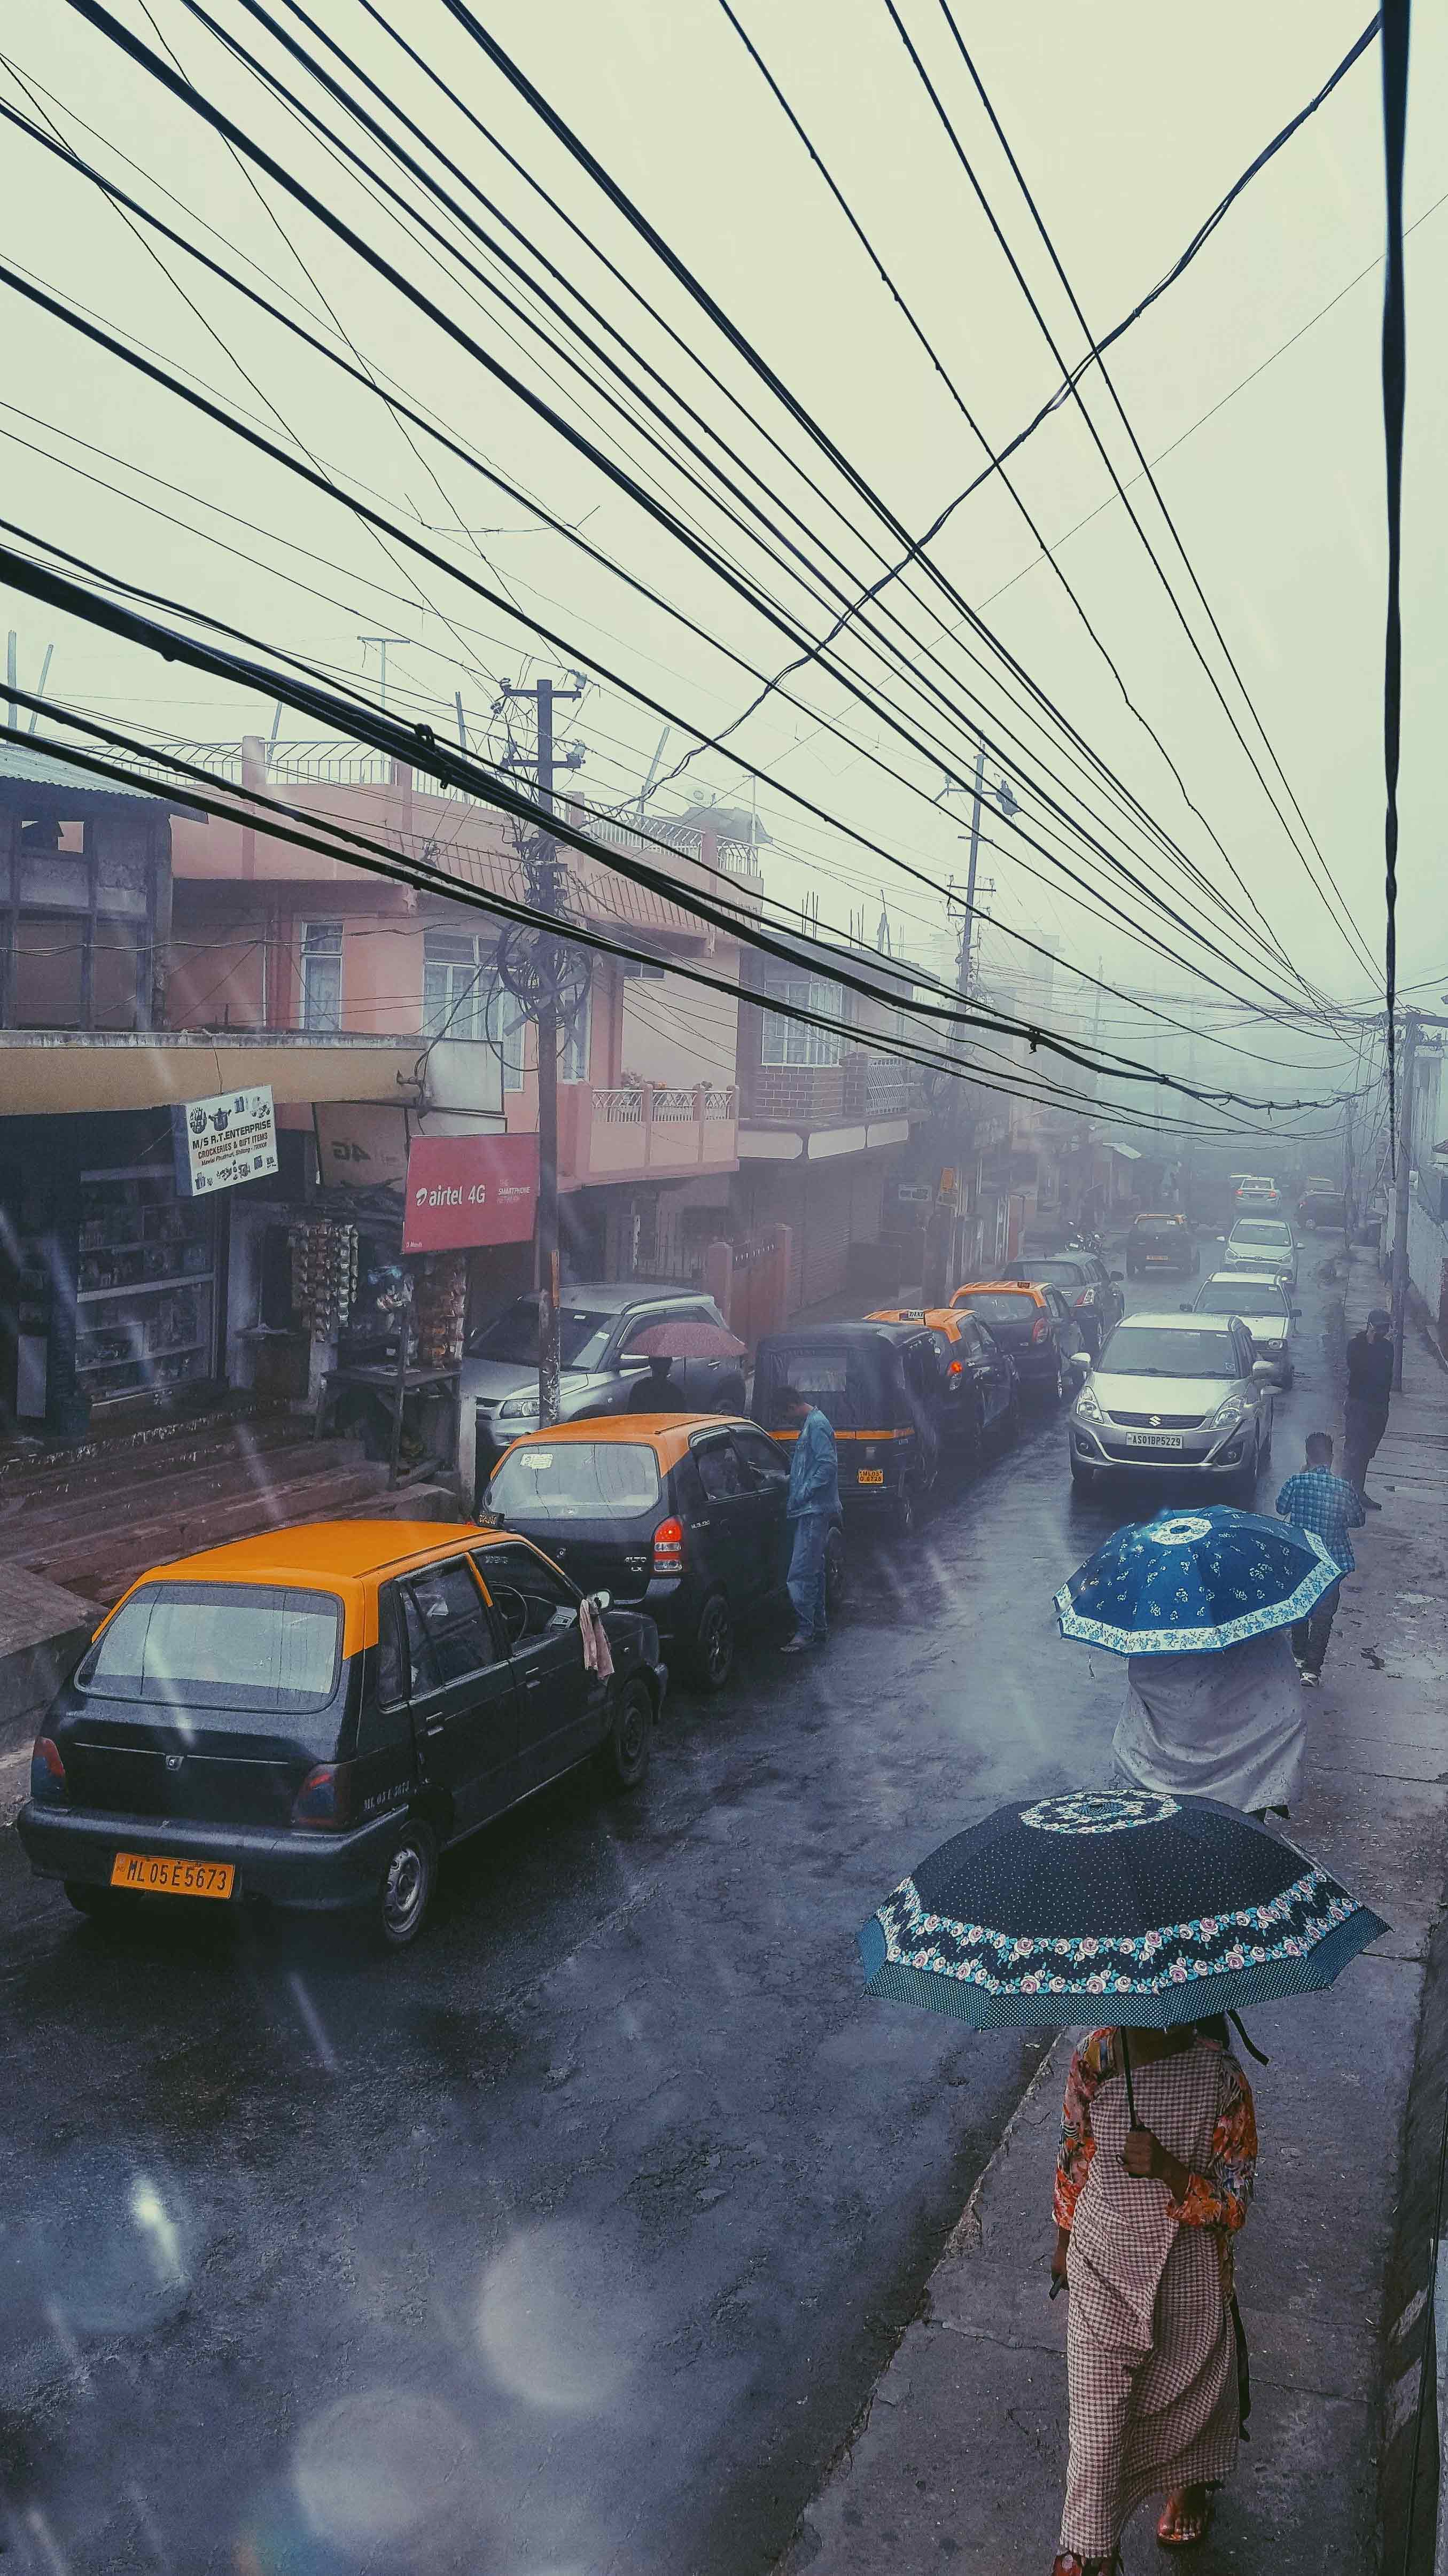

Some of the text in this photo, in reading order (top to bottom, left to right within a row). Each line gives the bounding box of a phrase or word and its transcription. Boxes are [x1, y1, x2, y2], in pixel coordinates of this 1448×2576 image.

[192, 1136, 208, 1150] M/S
[198, 1132, 268, 1159] CROCKERIES & GIFT ITEMS
[429, 1184, 486, 1206] airtel 4G
